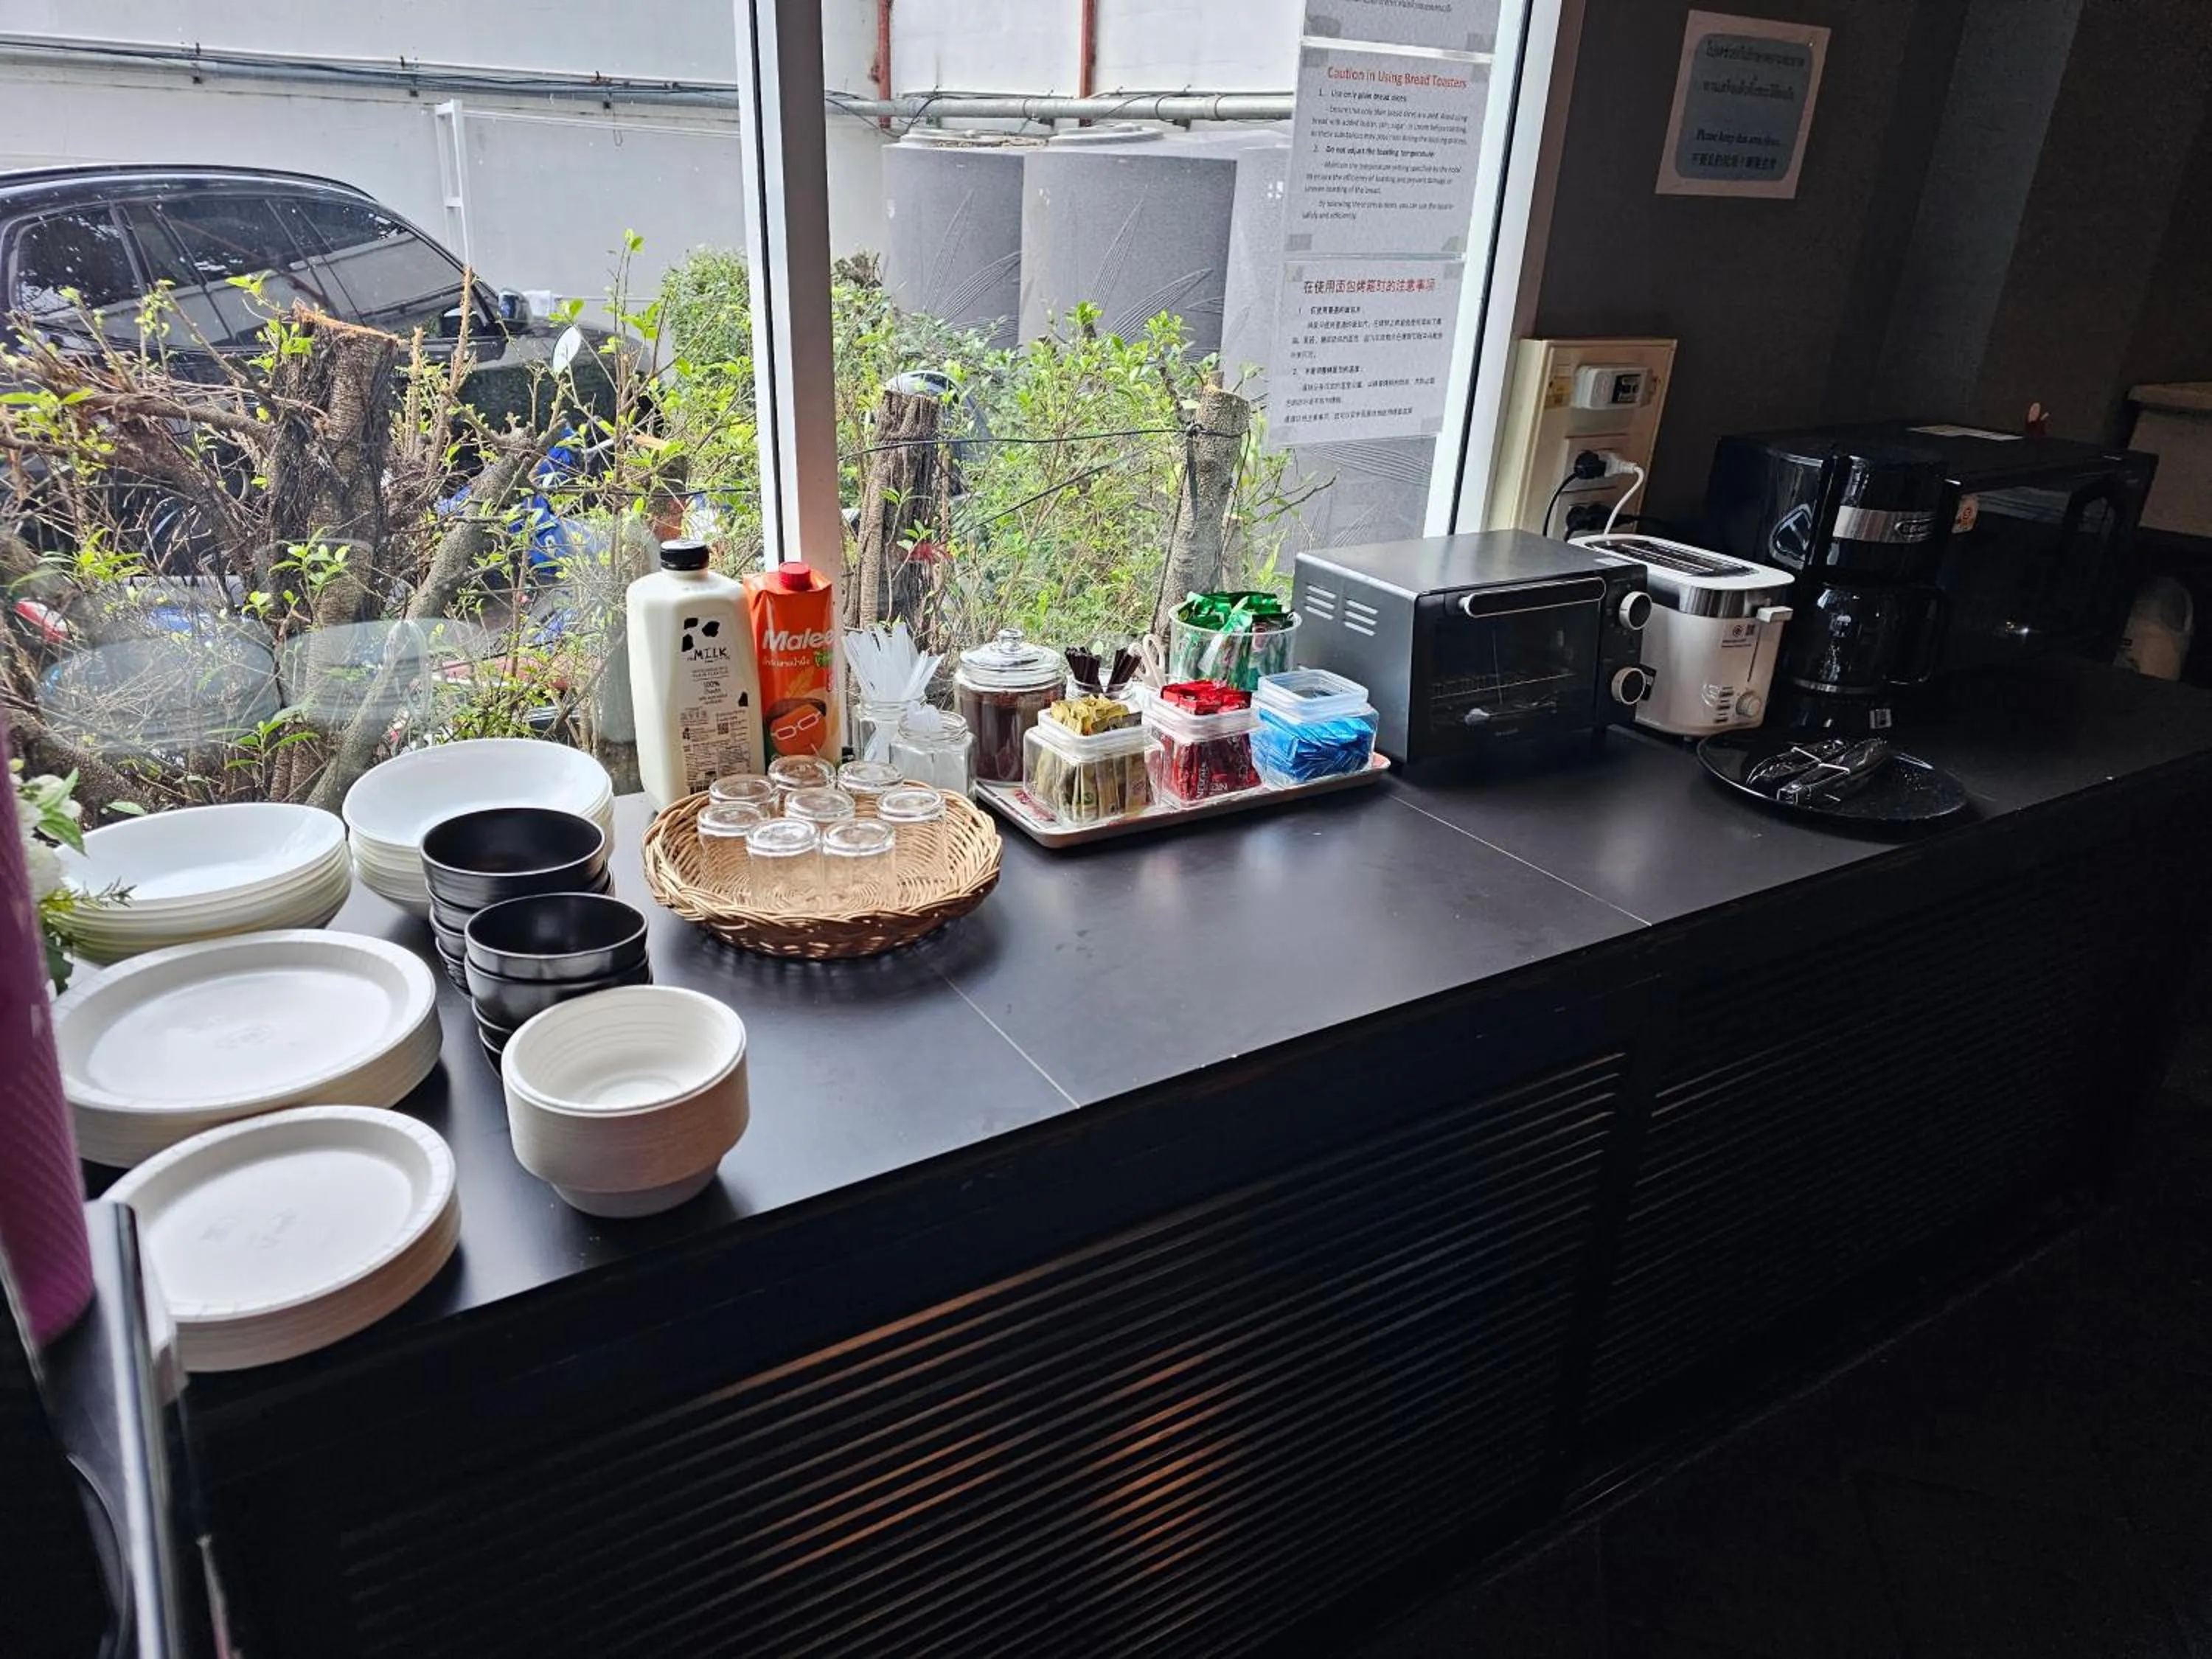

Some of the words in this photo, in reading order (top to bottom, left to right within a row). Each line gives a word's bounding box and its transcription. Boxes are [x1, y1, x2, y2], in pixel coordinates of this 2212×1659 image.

[1328, 66, 1364, 80] Caution
[1367, 70, 1375, 82] in
[1378, 71, 1402, 86] Using
[1405, 73, 1430, 86] Bread
[1433, 74, 1467, 88] Toasters
[762, 627, 835, 652] Malee
[694, 647, 727, 661] MILK
